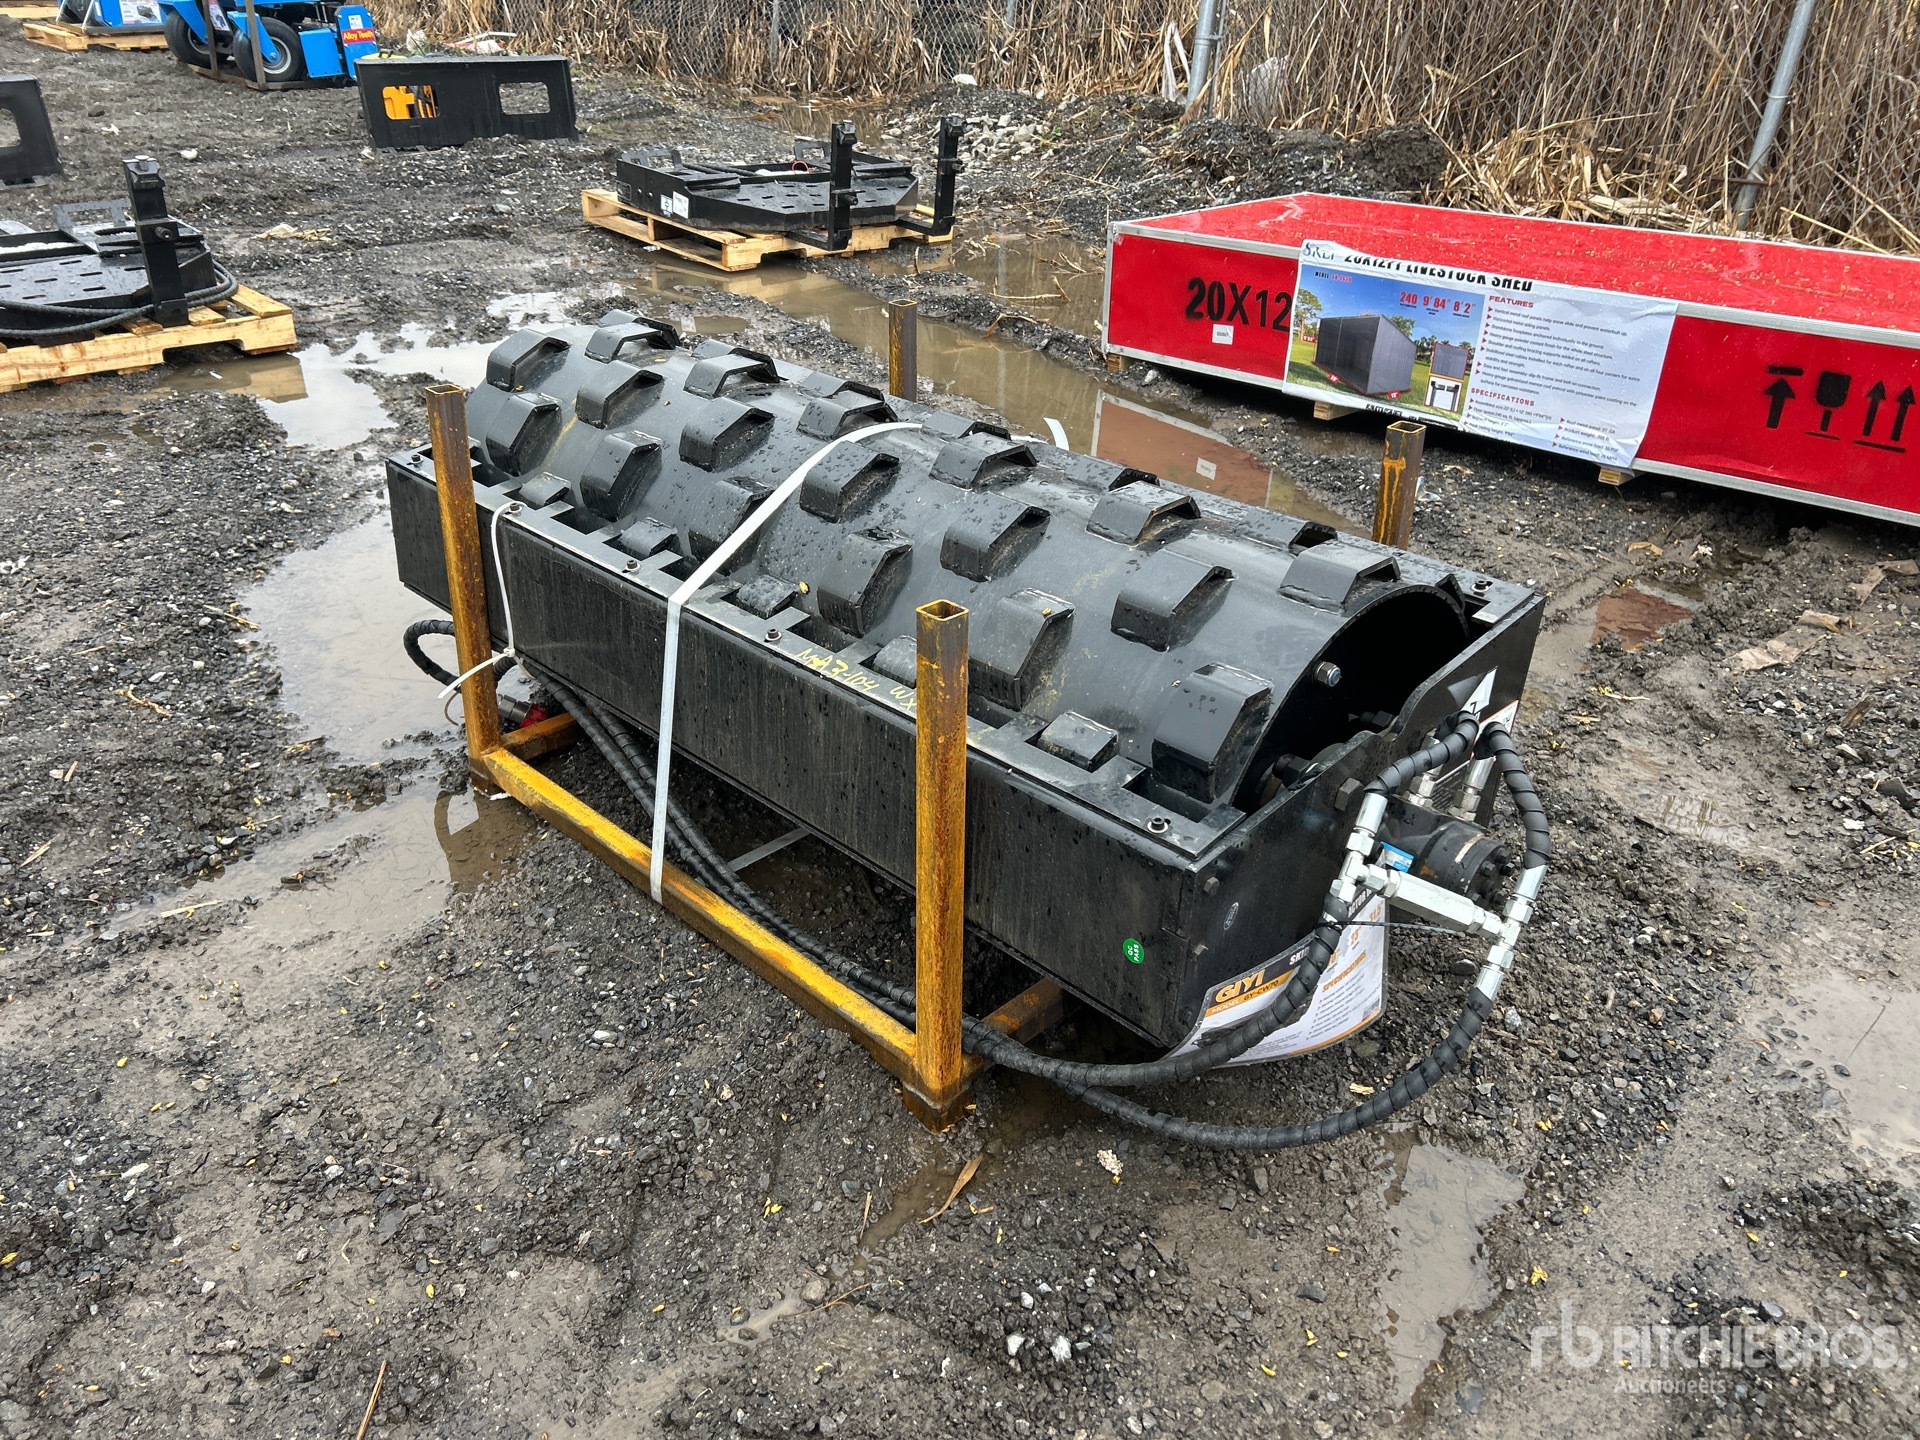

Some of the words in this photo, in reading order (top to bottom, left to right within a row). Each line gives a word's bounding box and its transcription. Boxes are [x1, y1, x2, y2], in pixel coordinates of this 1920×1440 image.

[1185, 277, 1293, 332] 20X12
[1400, 291, 1417, 305] 240
[1488, 295, 1534, 308] FEATURES
[1127, 945, 1134, 956] QC
[1211, 1000, 1239, 1014] MODEL
[1243, 980, 1279, 1001] GY-CW70
[1215, 969, 1265, 1003] GIYI
